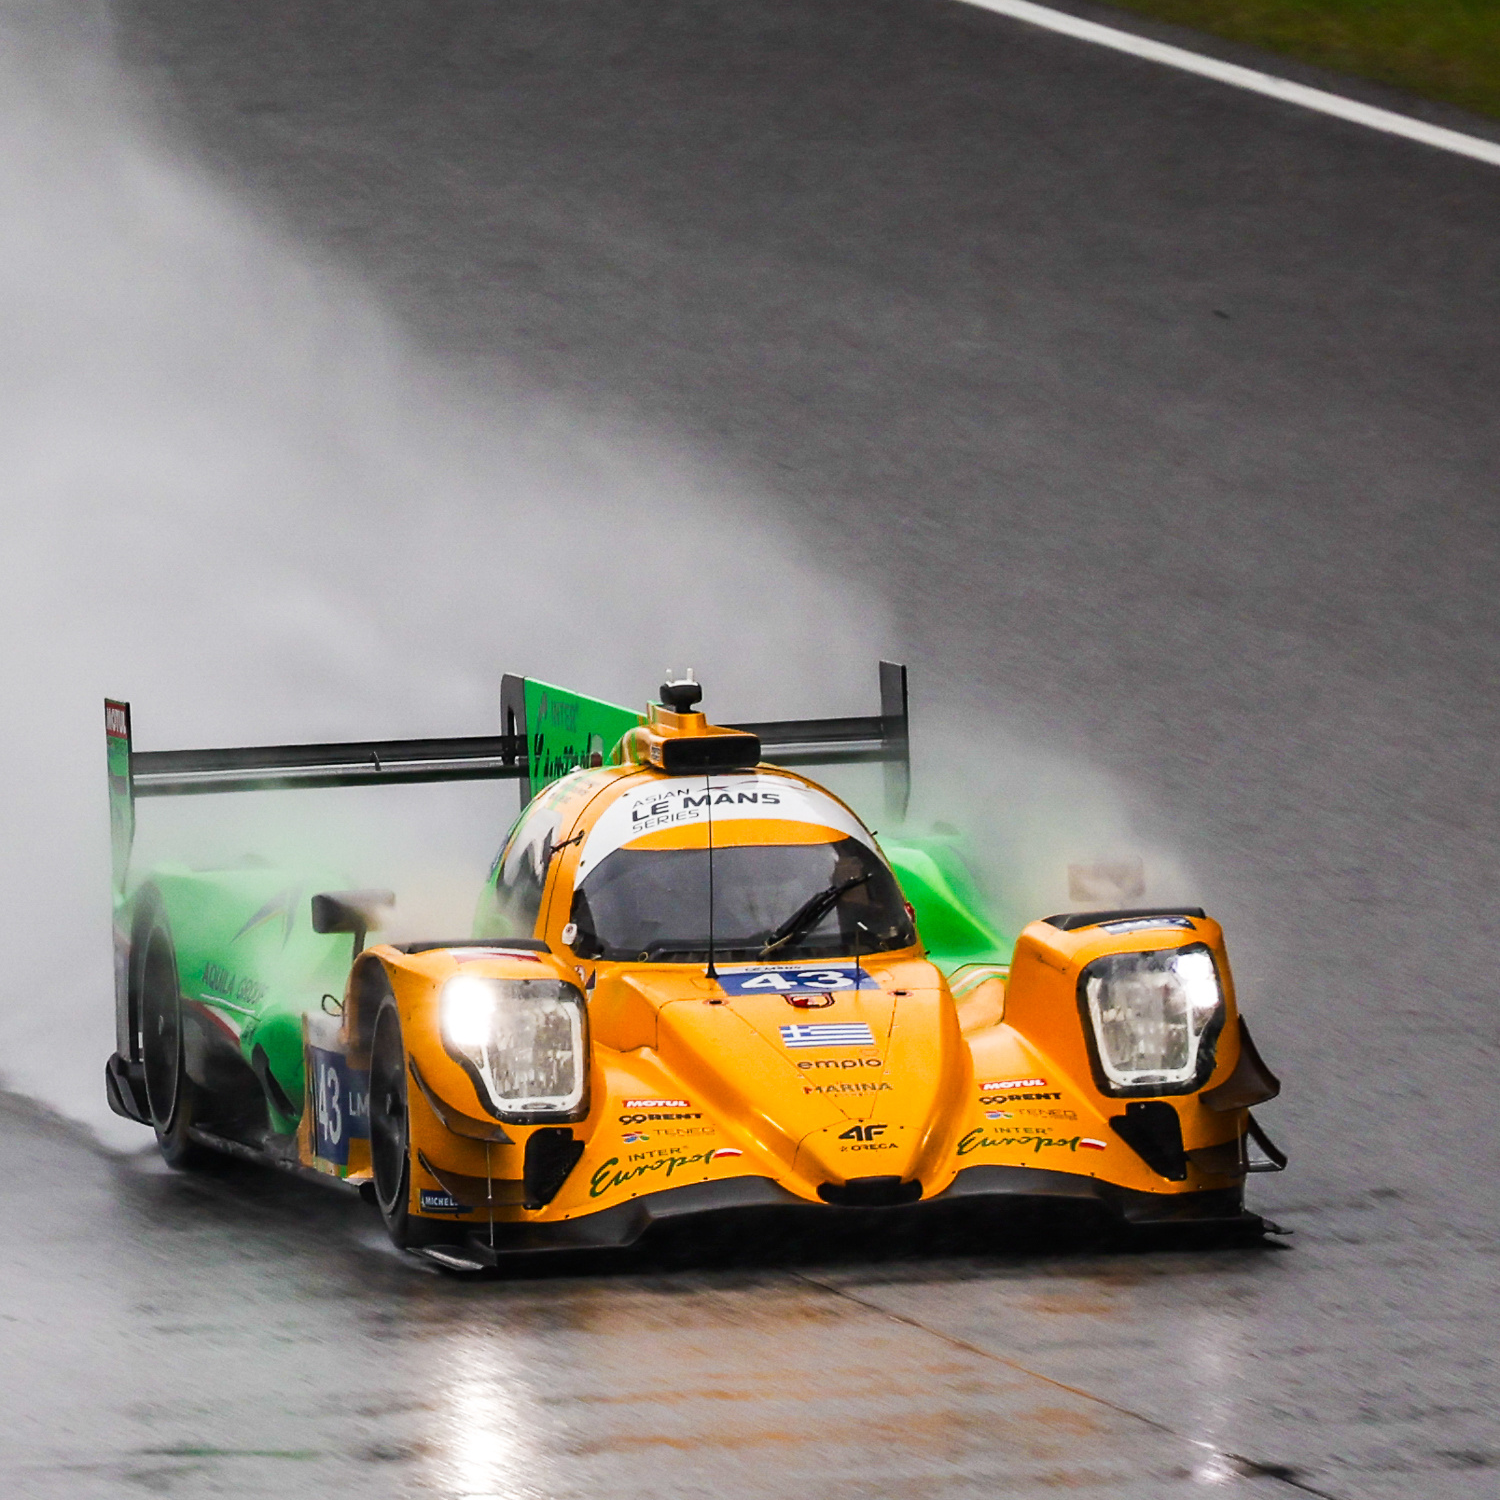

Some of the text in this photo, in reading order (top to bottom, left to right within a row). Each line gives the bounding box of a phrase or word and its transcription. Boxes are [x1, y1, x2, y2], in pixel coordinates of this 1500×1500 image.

[632, 788, 690, 809] ASIAN
[632, 792, 781, 823] LE MANS
[632, 808, 700, 834] SERIES
[741, 970, 854, 990] 43
[797, 1058, 882, 1070] emplo
[803, 1082, 893, 1095] MARINA
[983, 1078, 1045, 1091] MOTUL
[319, 1063, 342, 1145] 43
[626, 1100, 688, 1108] MOTUL
[851, 1142, 899, 1151] ORECA
[956, 1128, 1081, 1156] Europol
[628, 1147, 682, 1162] INTER
[589, 1149, 716, 1198] Europol
